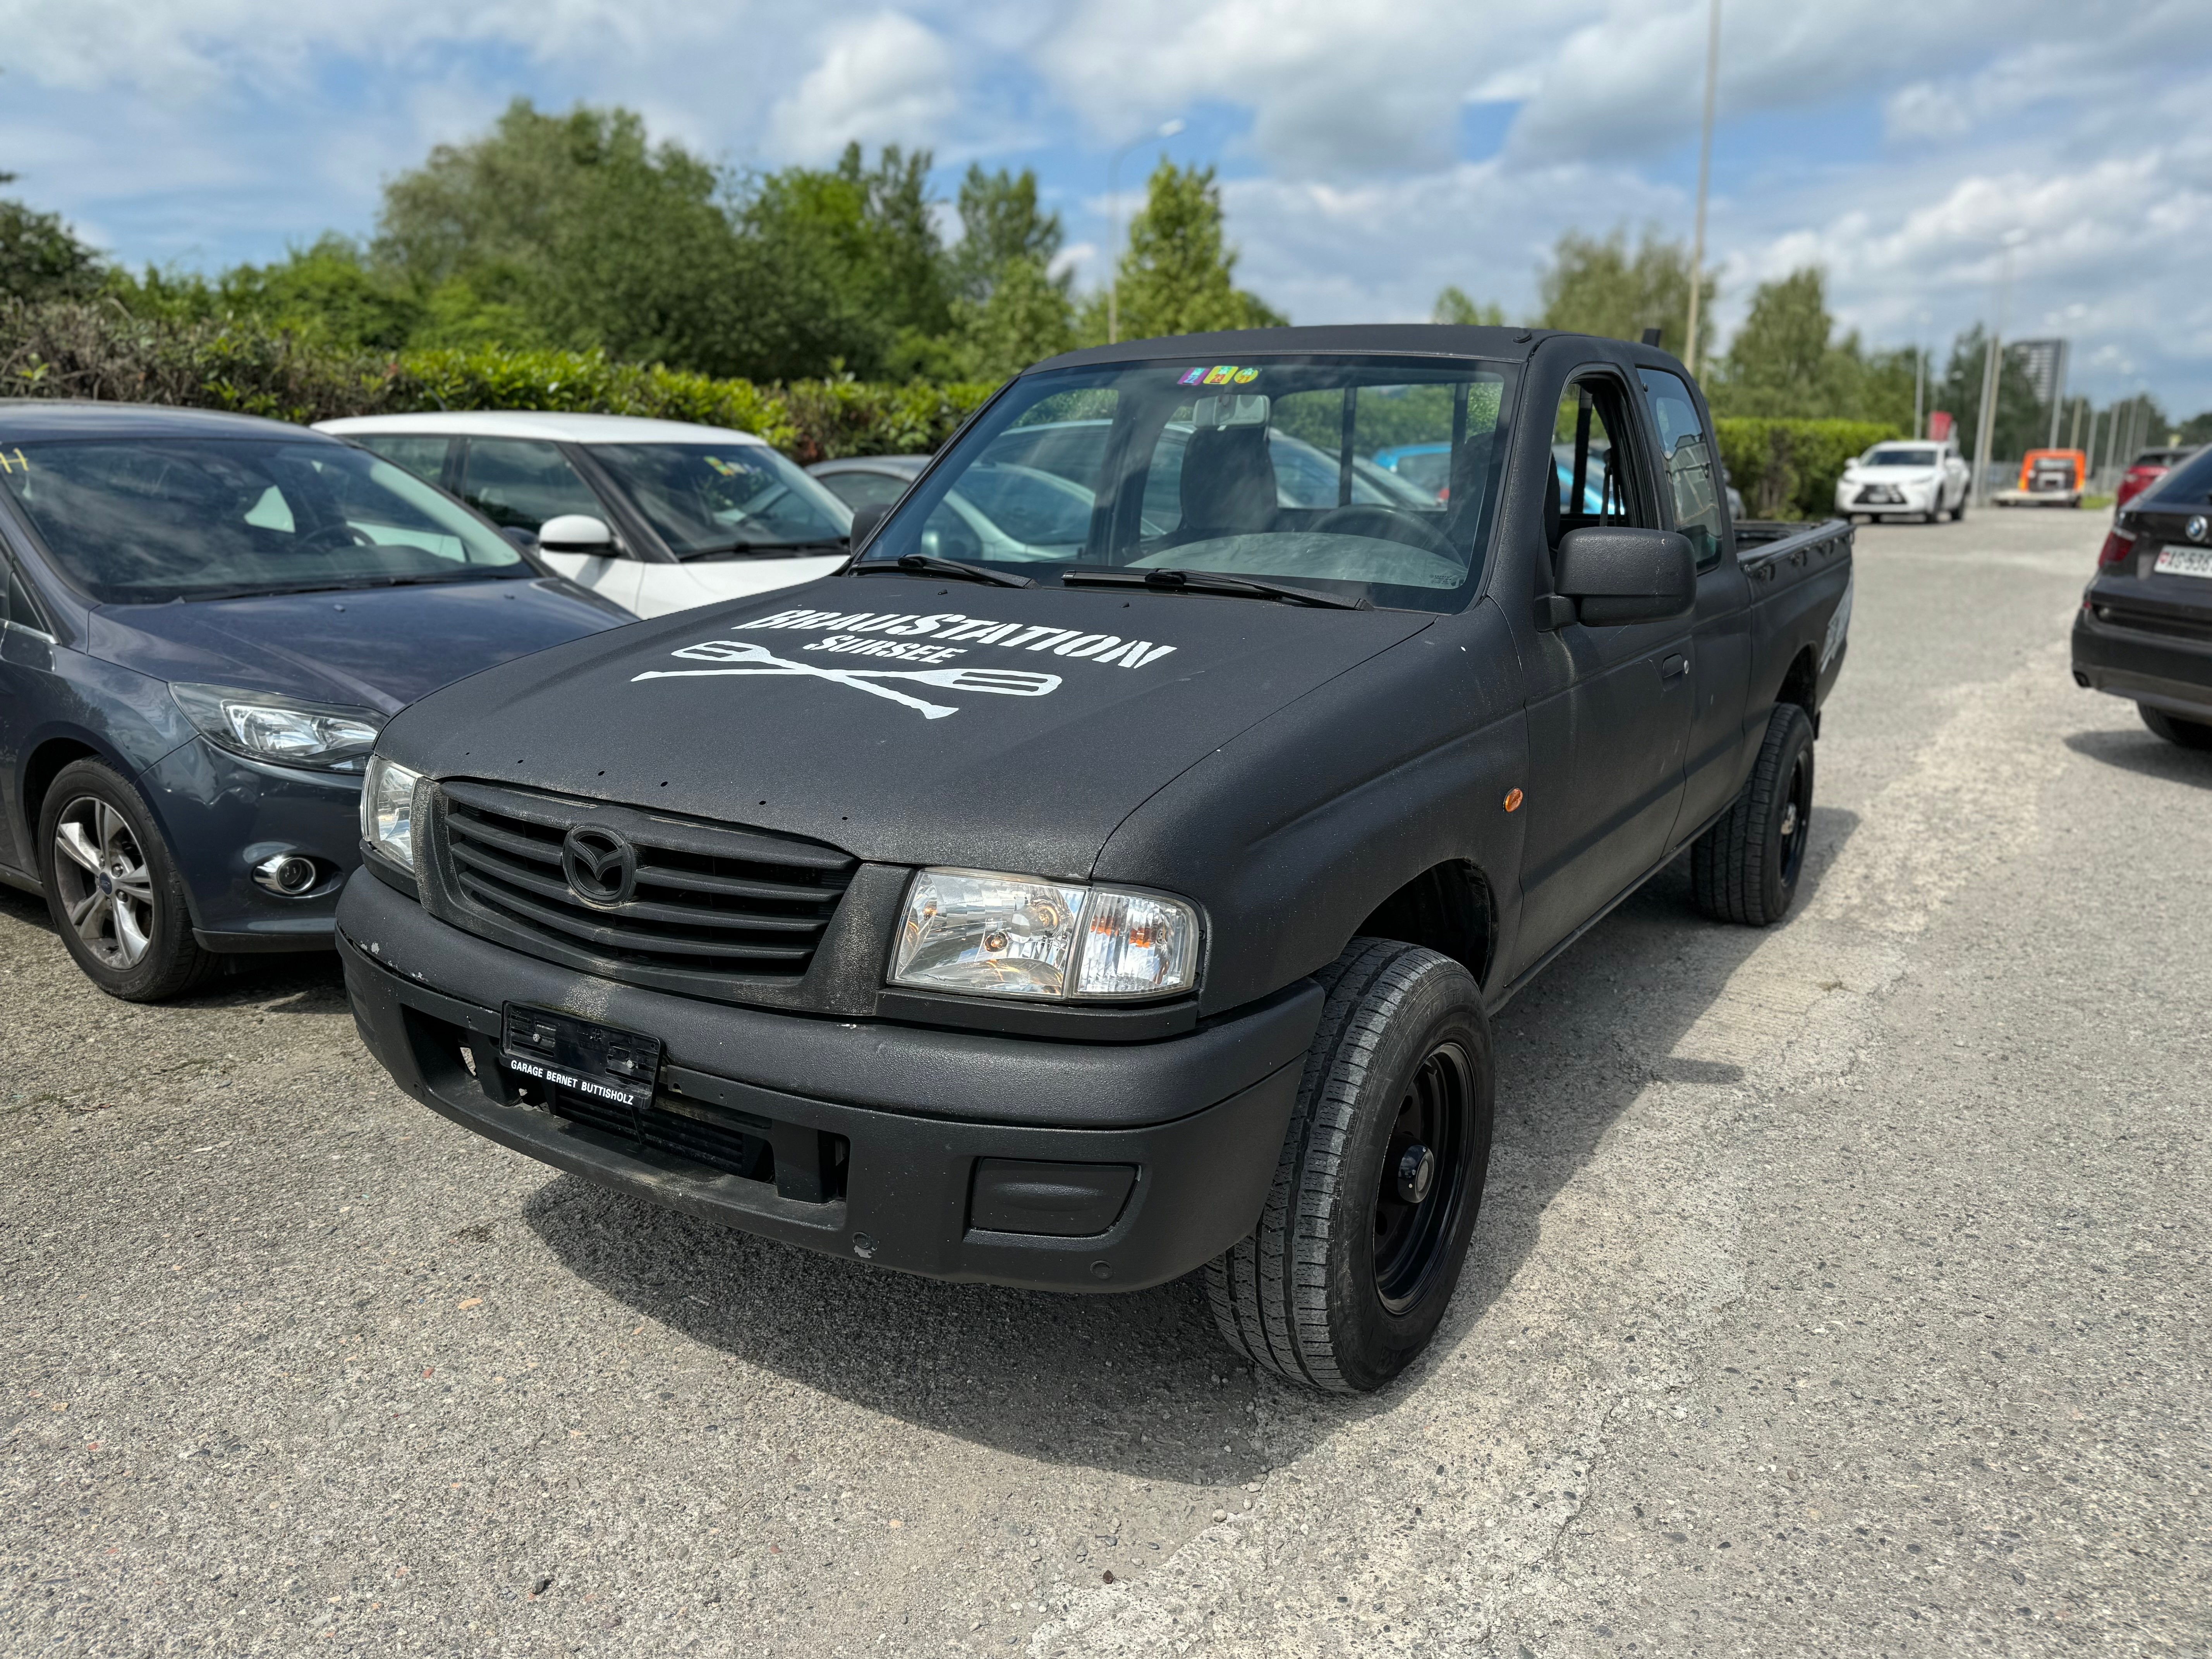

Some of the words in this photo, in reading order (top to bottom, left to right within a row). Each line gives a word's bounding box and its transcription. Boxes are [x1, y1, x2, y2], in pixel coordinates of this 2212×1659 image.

[731, 610, 1178, 669] BRAUSTATION
[802, 635, 969, 664] SURSEE
[511, 1060, 543, 1078] GARAGE
[546, 1070, 578, 1088] BERNET
[581, 1081, 634, 1105] BUTTISHOLZ
